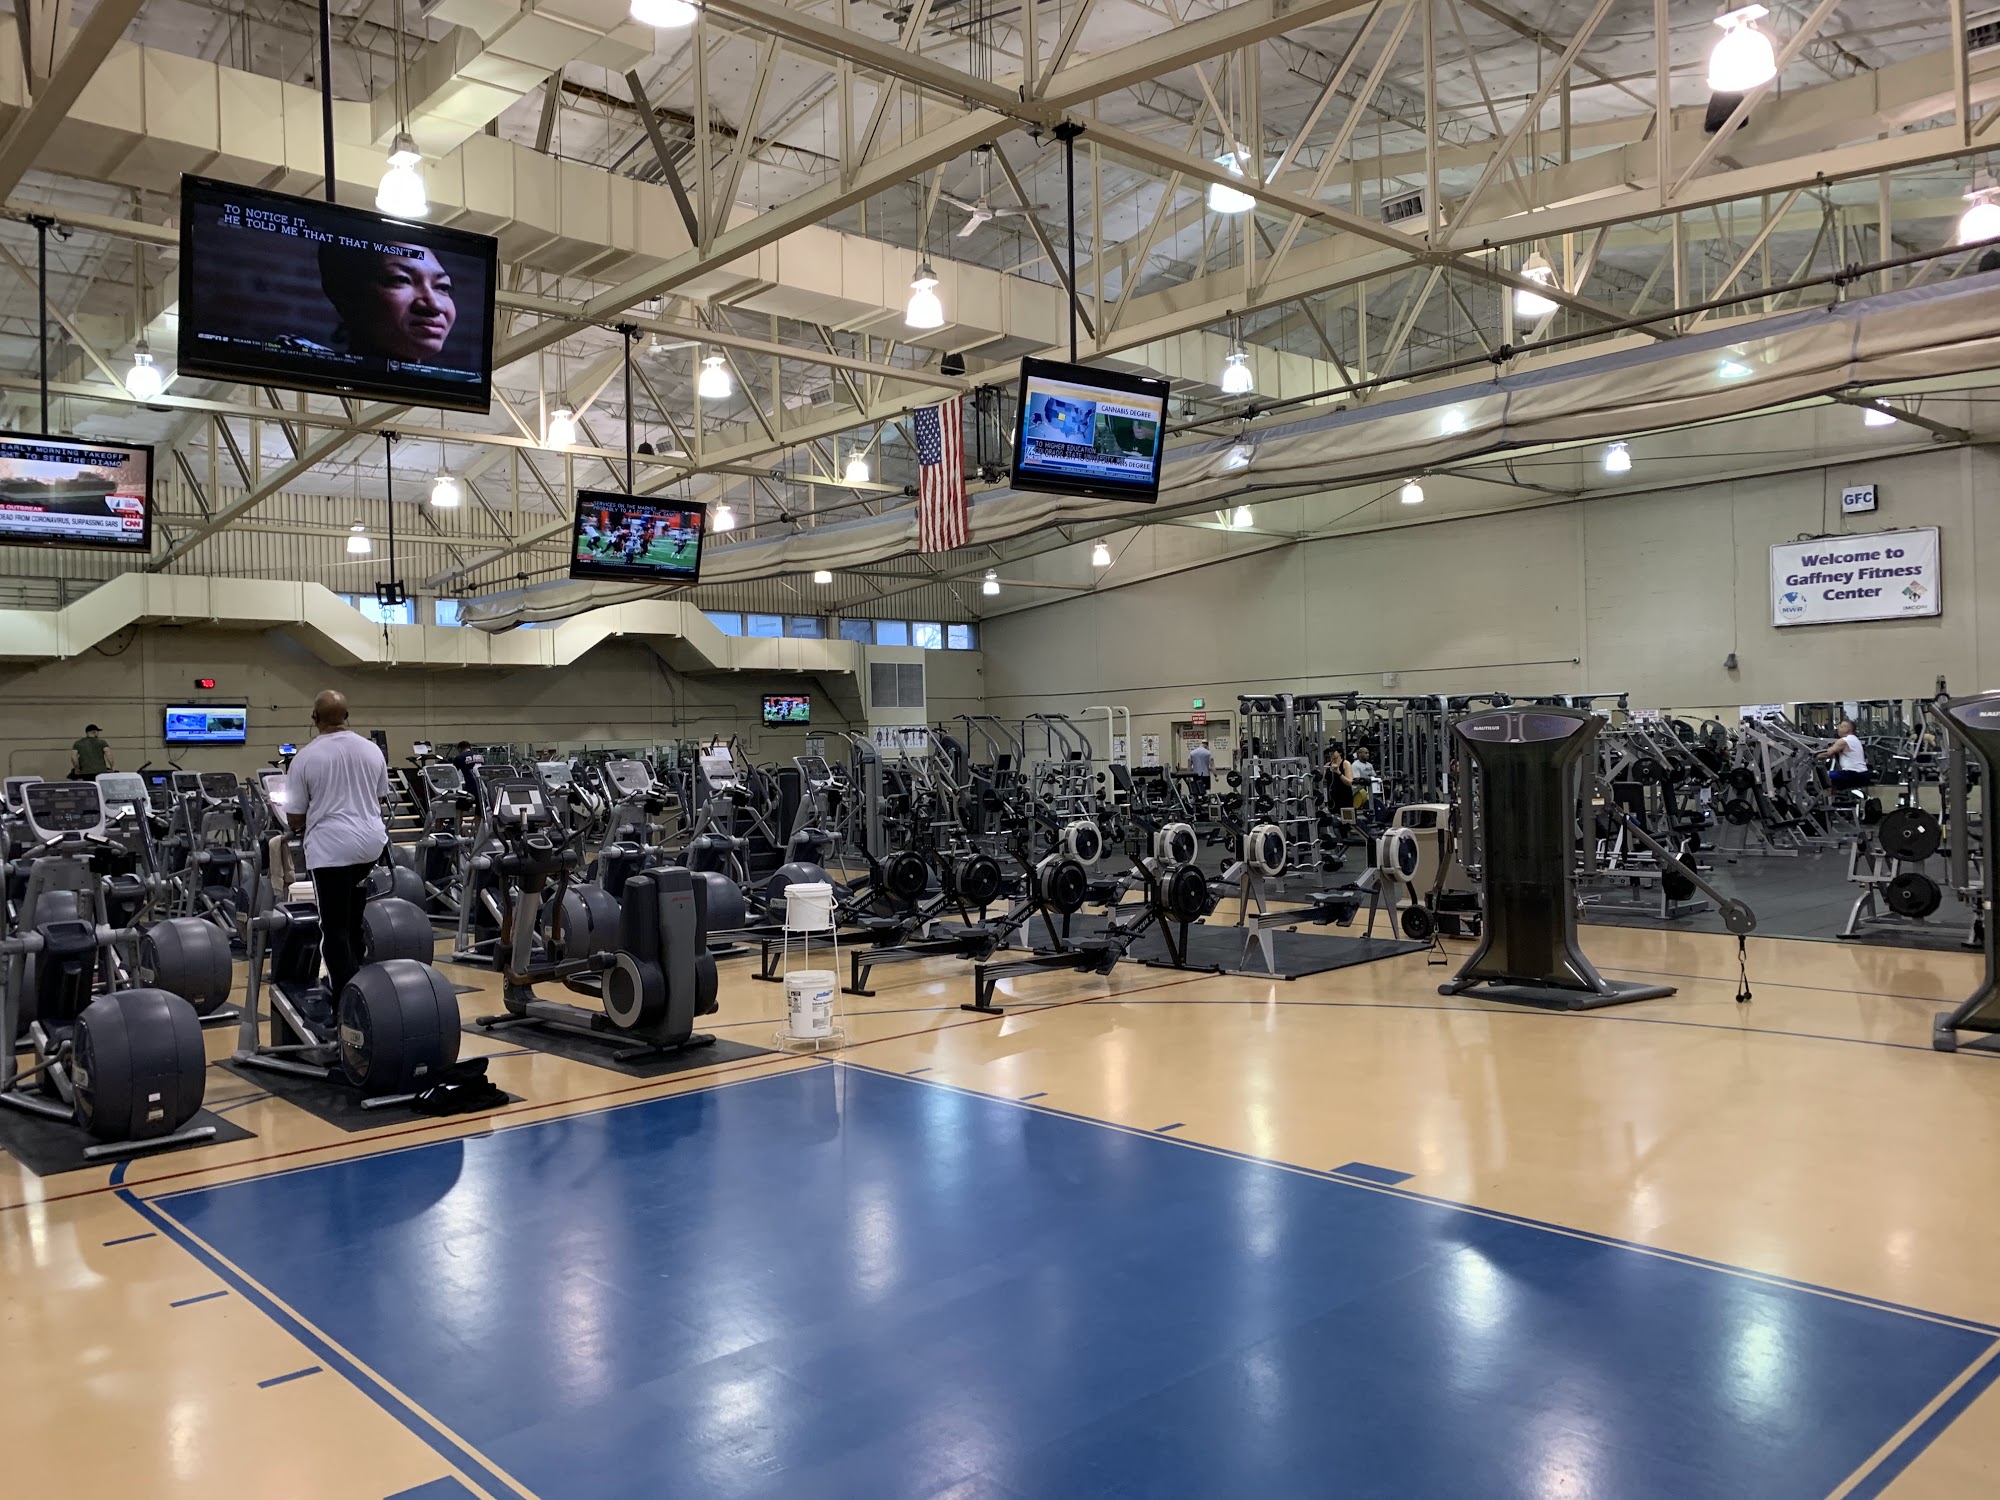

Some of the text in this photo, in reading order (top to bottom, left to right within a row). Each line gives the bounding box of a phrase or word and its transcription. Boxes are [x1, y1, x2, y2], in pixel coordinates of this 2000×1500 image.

[224, 204, 307, 228] TO NOTICE IT.
[224, 214, 240, 225] HE
[246, 218, 276, 231] TOLD
[281, 225, 298, 236] ME
[303, 229, 333, 243] THAT
[339, 236, 368, 249] THAT
[373, 242, 412, 258] WASN'T
[1101, 405, 1151, 418] CANNABIS DEGREE
[1, 443, 32, 452] EARLY
[36, 447, 79, 456] MORNING
[1045, 442, 1065, 450] HIGHER
[26, 452, 38, 460] TO
[91, 459, 122, 468] DIAMO
[1129, 462, 1150, 470] DEGREE
[1844, 491, 1873, 505] GFC
[6, 504, 43, 512] OUTBREAK
[32, 515, 70, 525] CORONAVIRUS,
[72, 518, 104, 527] SURPASSING
[105, 520, 119, 528] SARS
[124, 520, 140, 528] CNN
[1801, 548, 1905, 567] Welcome to
[1786, 565, 1922, 586] Gaffney Fitness
[1823, 586, 1882, 601] Center
